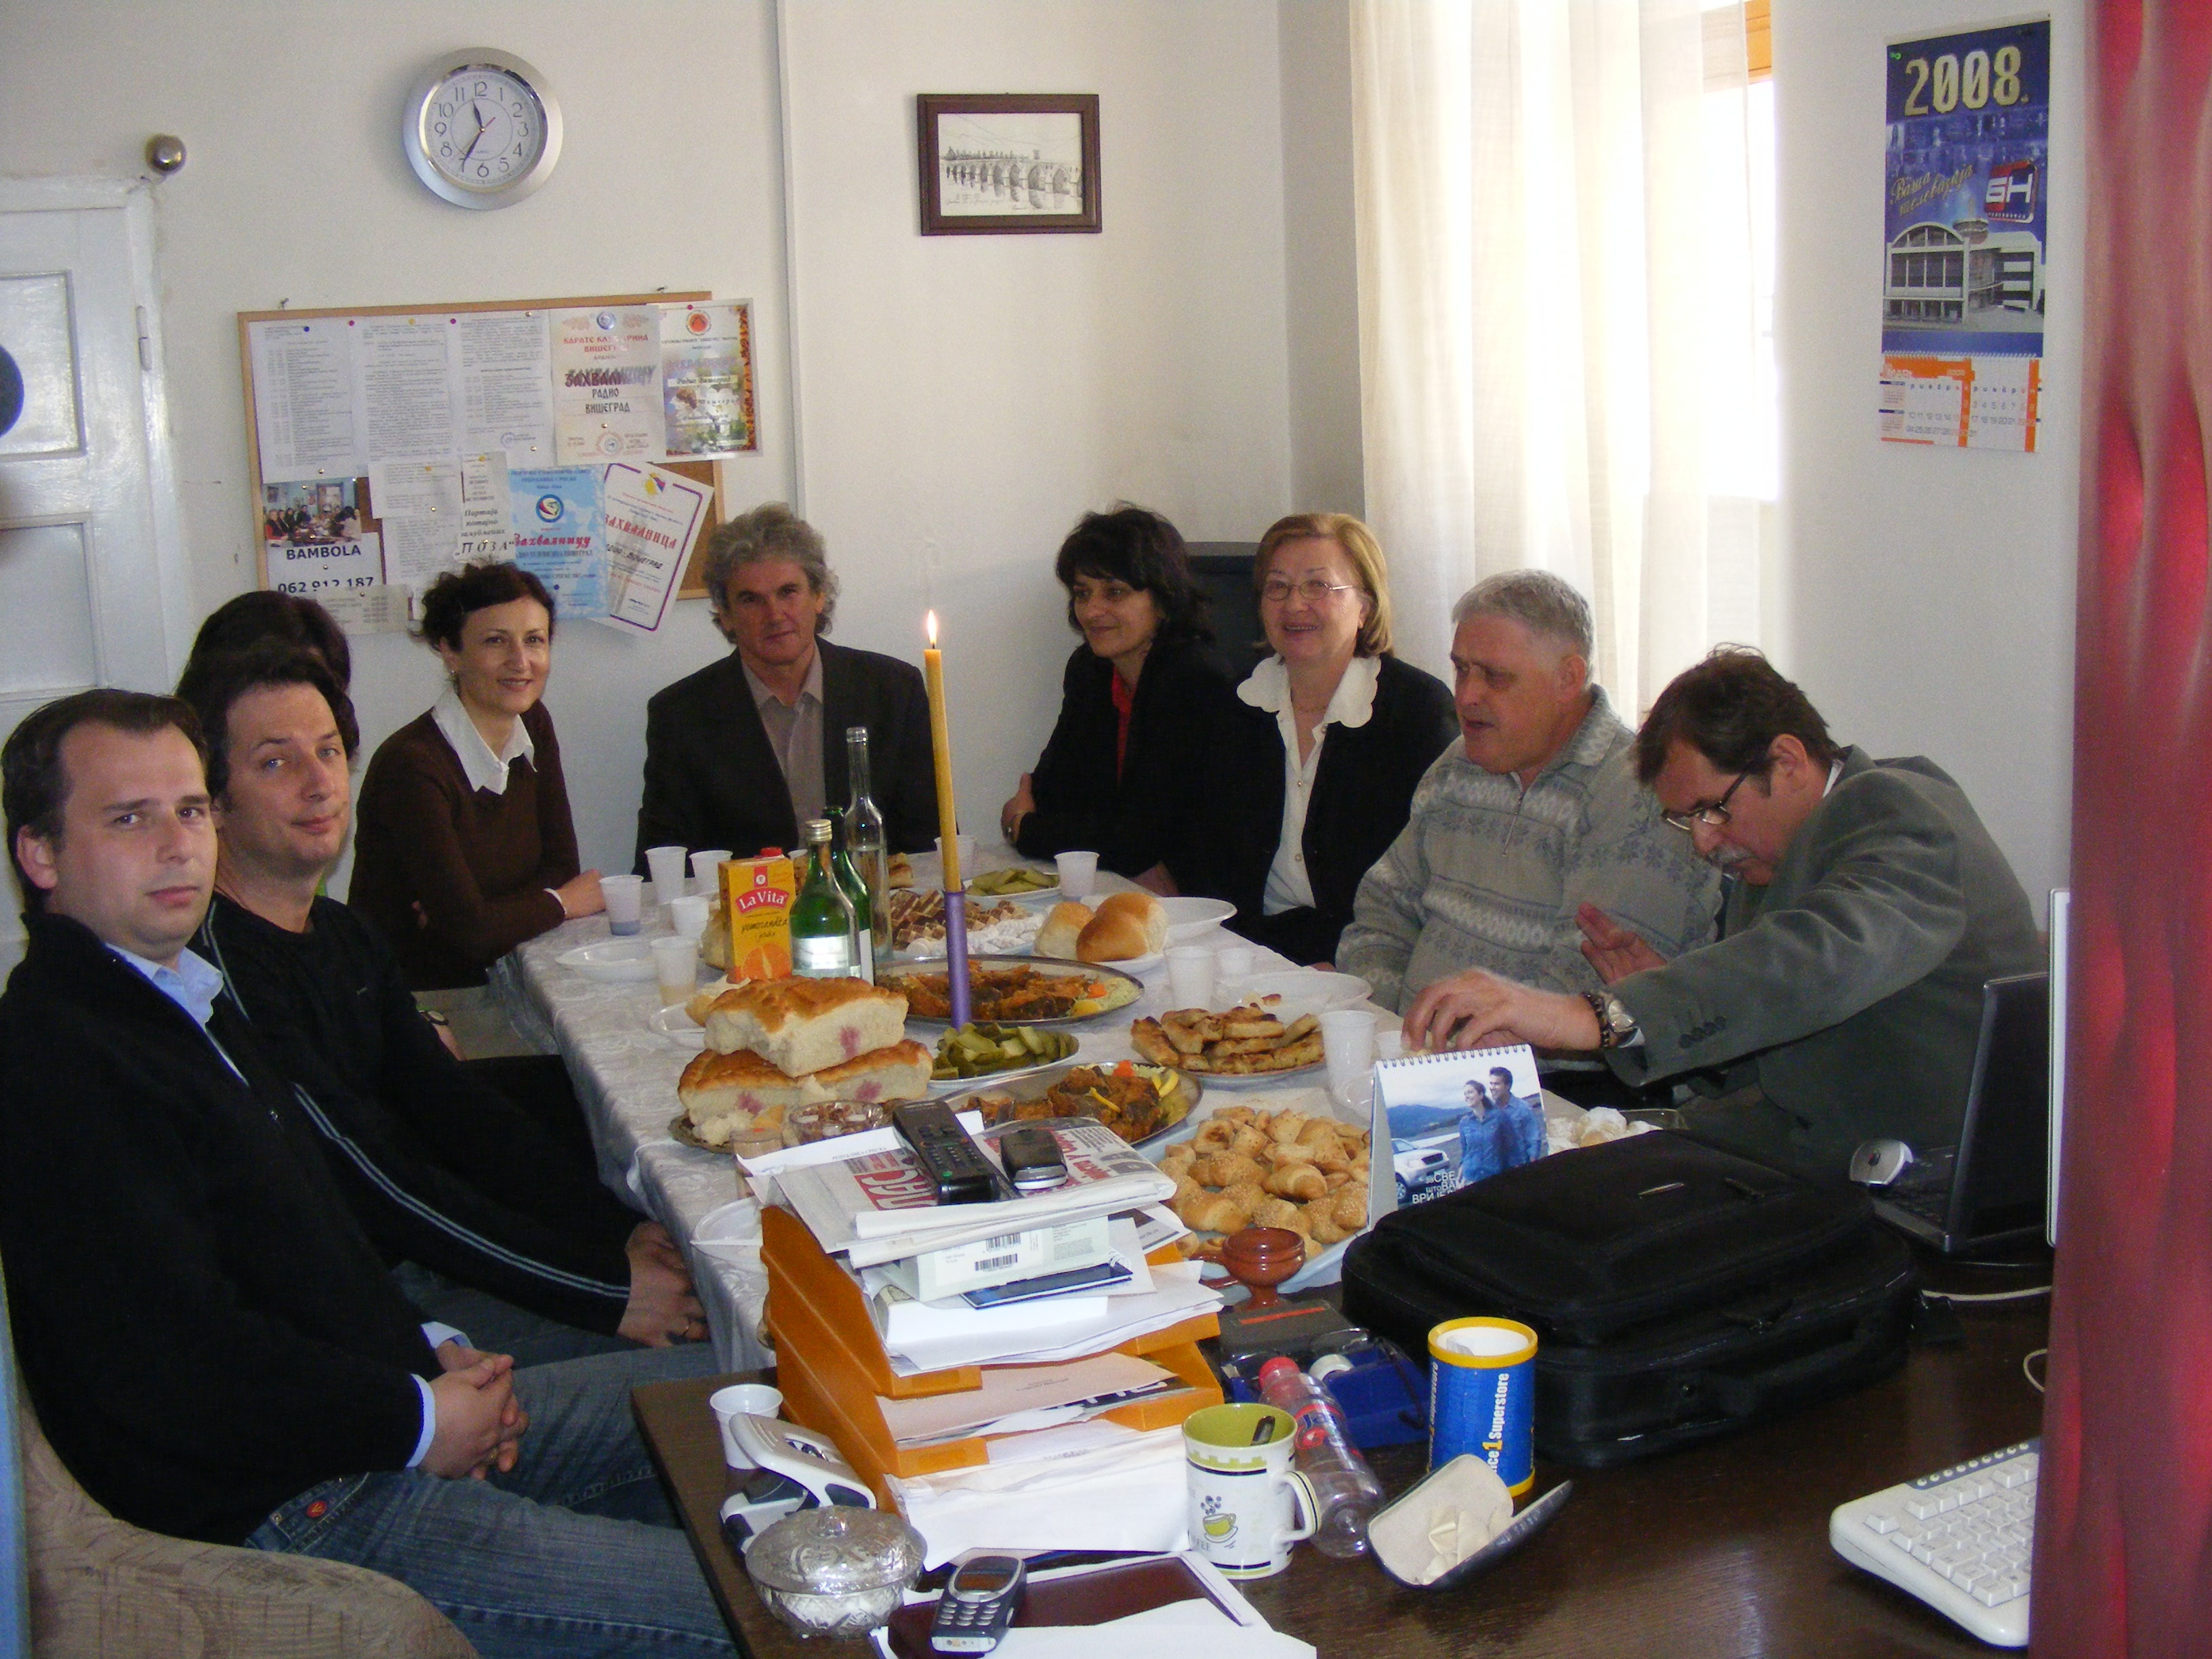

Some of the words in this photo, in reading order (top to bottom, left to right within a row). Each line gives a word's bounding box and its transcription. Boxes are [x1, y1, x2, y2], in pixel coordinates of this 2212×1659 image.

[1904, 45, 2029, 116] 2008.
[455, 87, 465, 102] 11
[474, 81, 488, 97] 12
[434, 102, 454, 118] 10
[512, 102, 523, 118] 2
[434, 121, 447, 138] 9
[517, 121, 529, 137] 3
[441, 141, 453, 157] 8
[512, 141, 523, 157] 4
[476, 163, 489, 178] 6
[497, 157, 510, 173] 5
[592, 388, 620, 398] РАДИО
[585, 402, 631, 414] ВИШЕГРАД
[286, 544, 362, 560] BAMBOLA
[278, 581, 306, 594] 062
[346, 576, 375, 588] 187
[738, 895, 757, 910] La
[756, 890, 785, 905] Vita
[1433, 1170, 1456, 1183] СВЕ
[1412, 1191, 1454, 1204] ВРИЈЕ
[1488, 1372, 1510, 1440] Superstore
